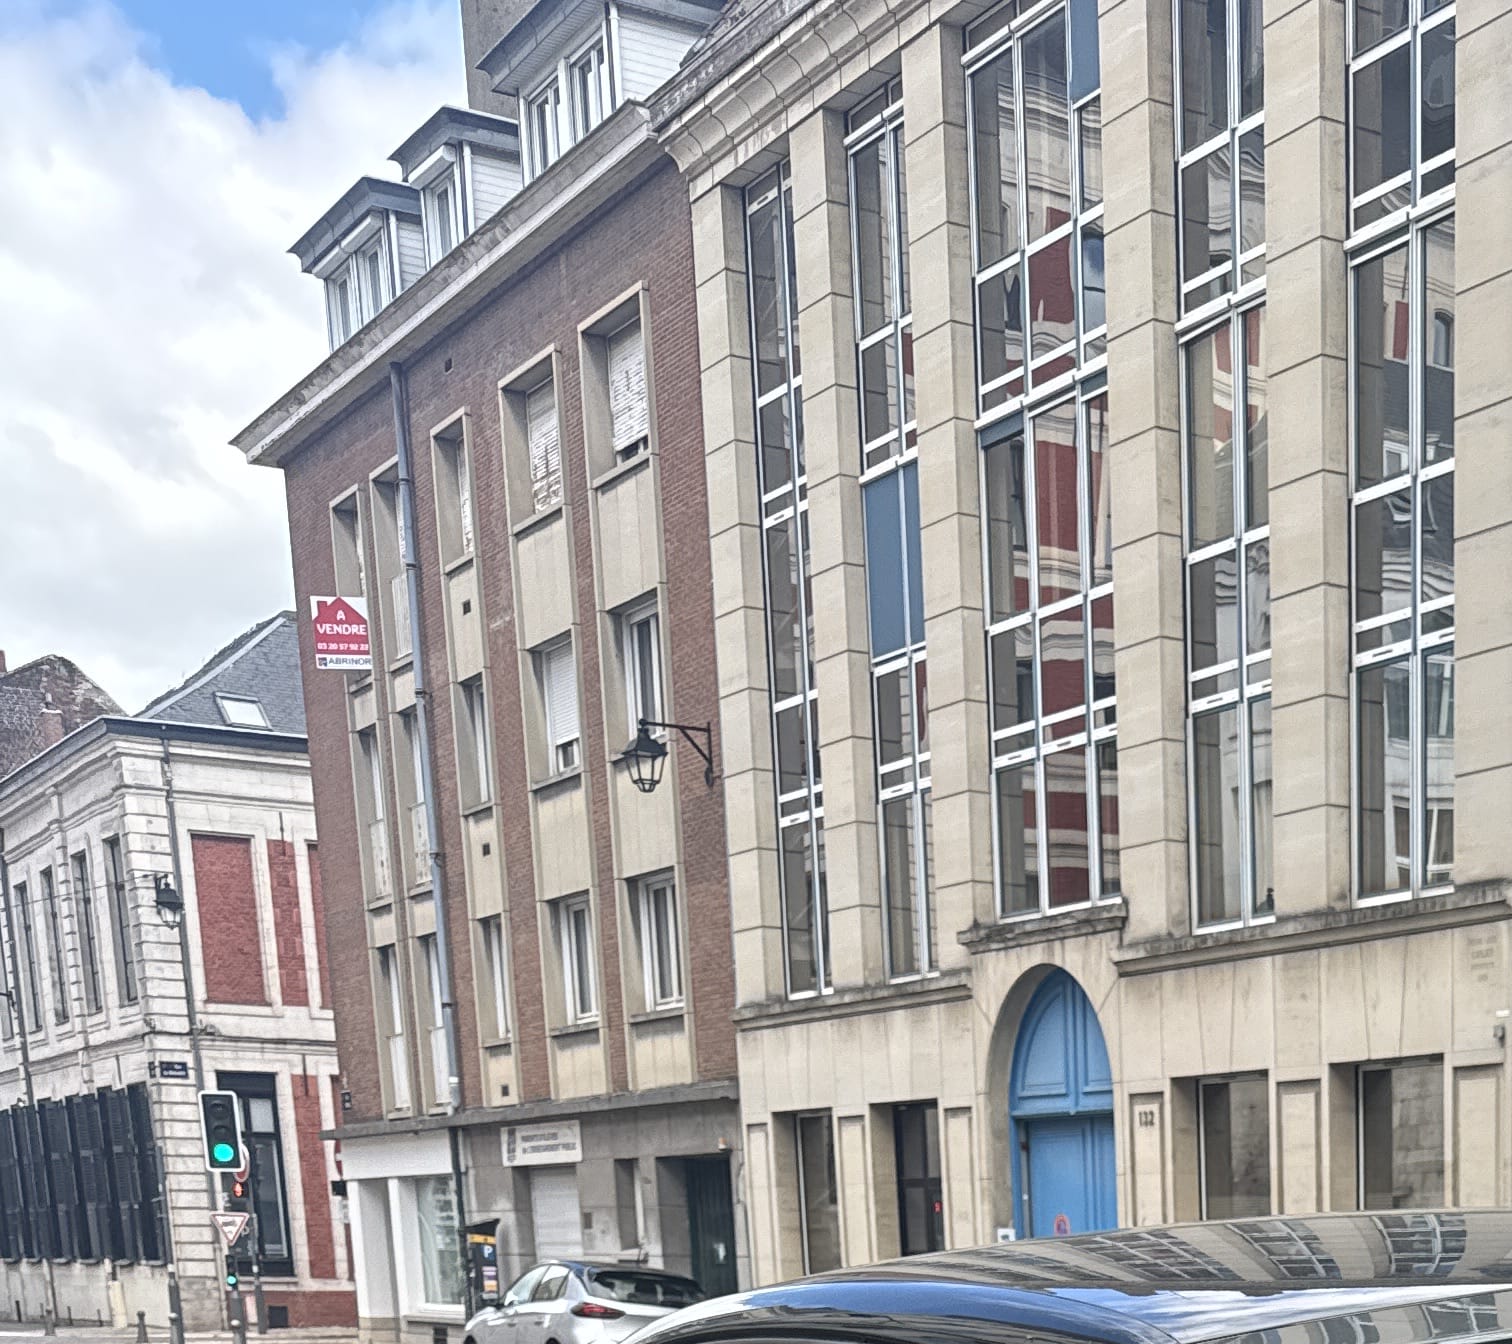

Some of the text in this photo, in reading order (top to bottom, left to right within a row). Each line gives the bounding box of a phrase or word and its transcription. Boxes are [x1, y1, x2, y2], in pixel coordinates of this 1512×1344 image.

[336, 610, 346, 621] A
[316, 624, 367, 635] VENDRE
[483, 1245, 494, 1259] P
